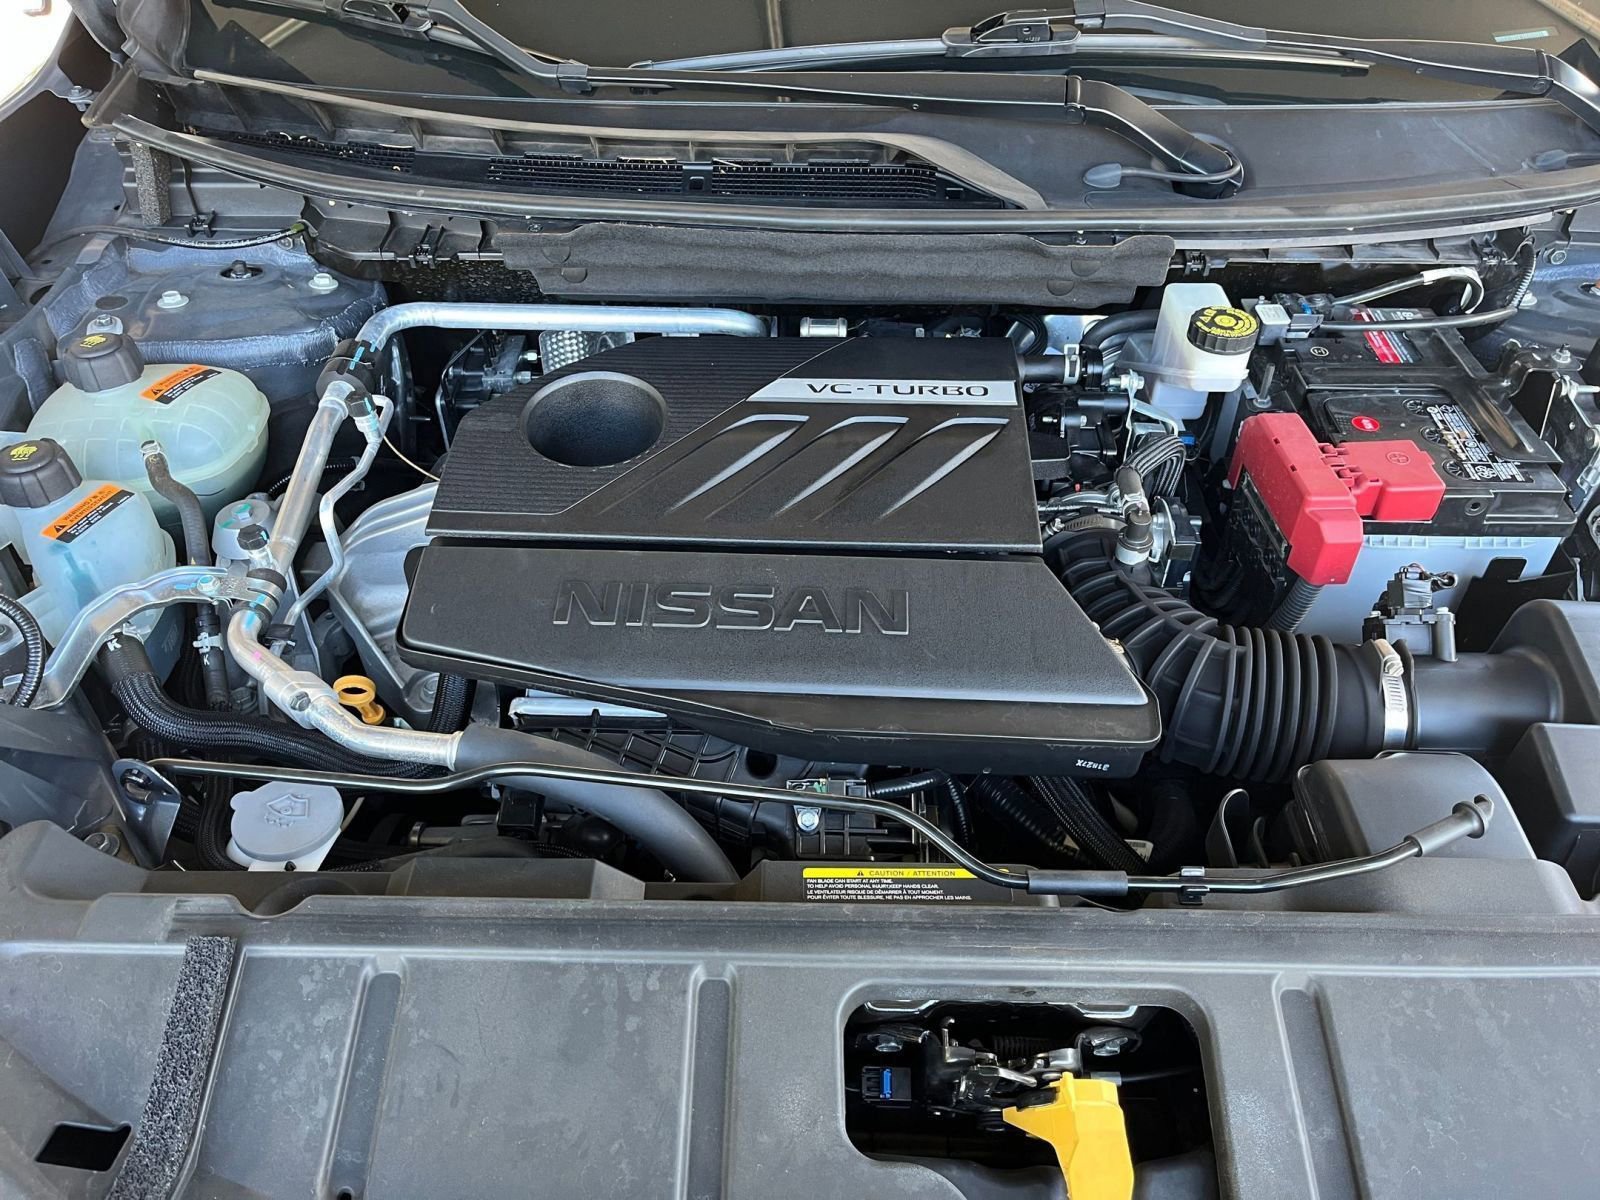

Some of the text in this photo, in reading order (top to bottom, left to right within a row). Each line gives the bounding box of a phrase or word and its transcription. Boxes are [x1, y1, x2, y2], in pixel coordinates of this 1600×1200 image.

[806, 383, 989, 397] VC-TURBO
[553, 580, 909, 635] NISSAN
[106, 638, 122, 652] K
[203, 654, 210, 666] K
